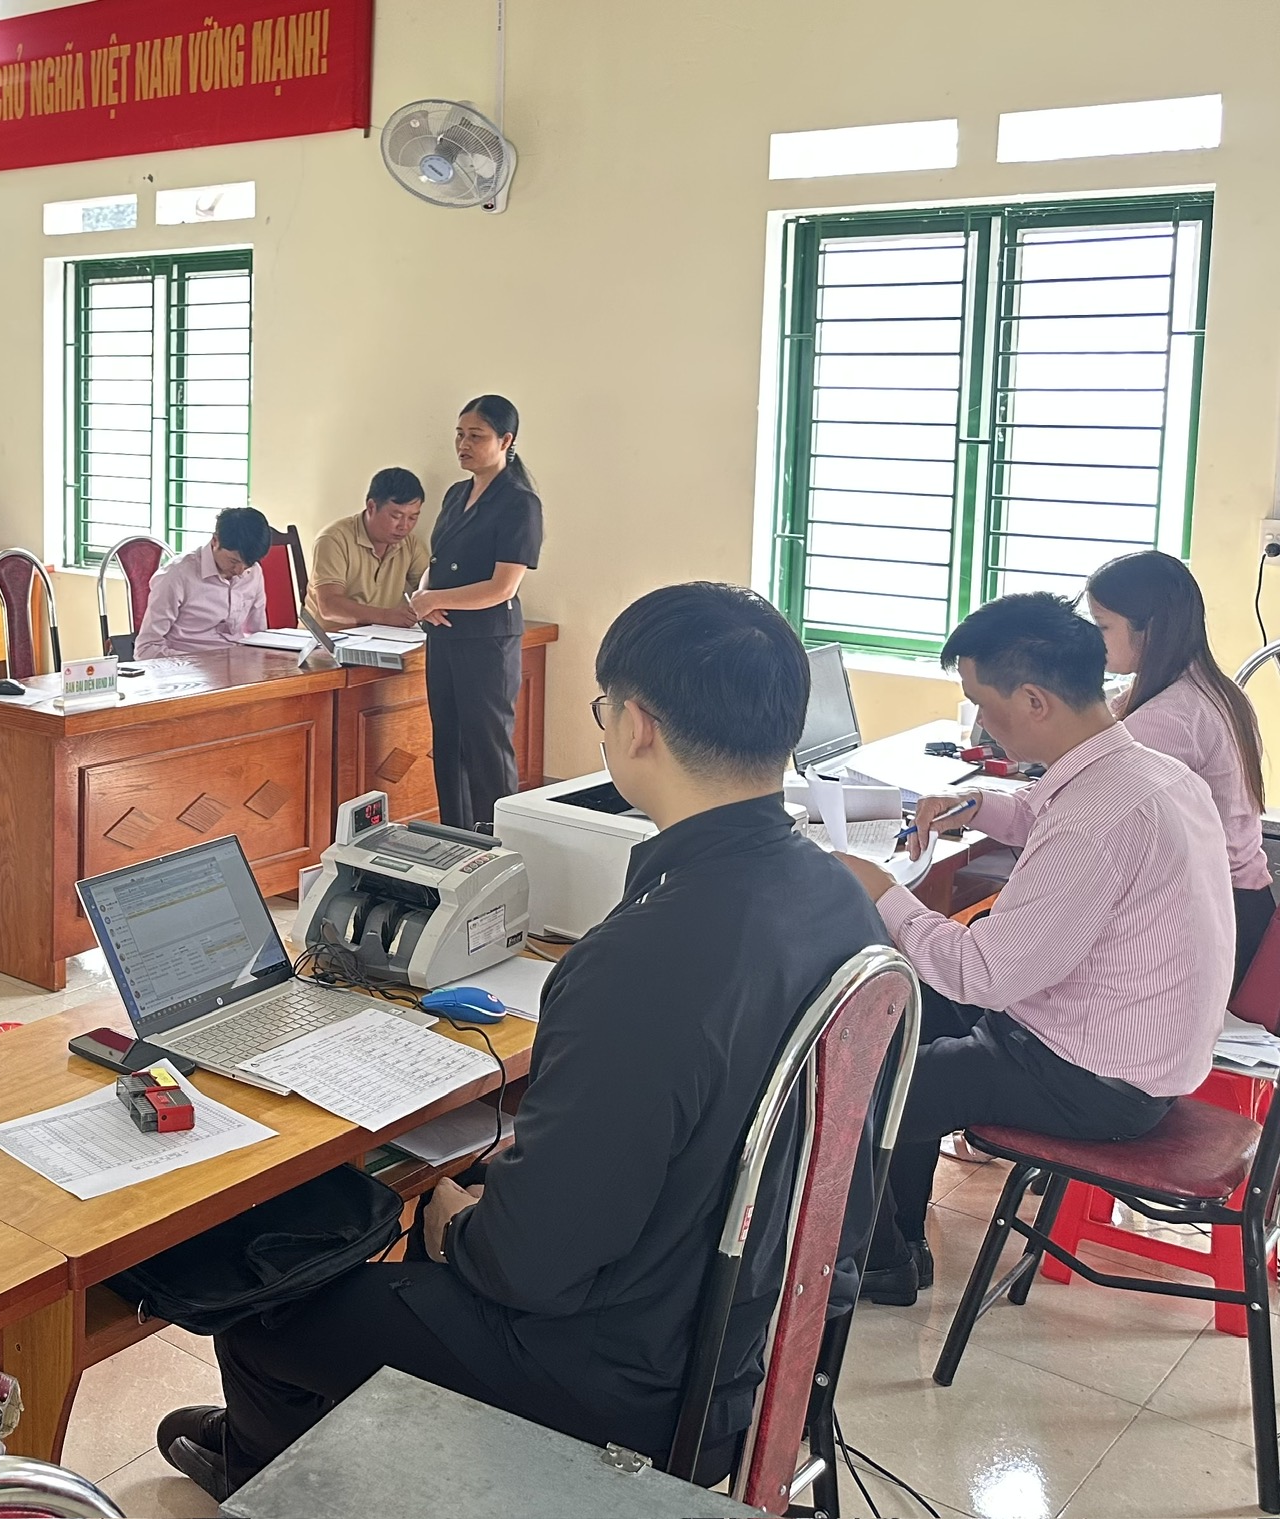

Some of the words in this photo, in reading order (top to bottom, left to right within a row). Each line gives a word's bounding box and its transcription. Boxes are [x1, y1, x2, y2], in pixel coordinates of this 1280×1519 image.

[30, 41, 85, 117] NGHĨA
[90, 33, 131, 120] VIỆT
[134, 35, 183, 102] NAM
[188, 16, 245, 94] VỮNG
[251, 8, 330, 97] MẠNH!
